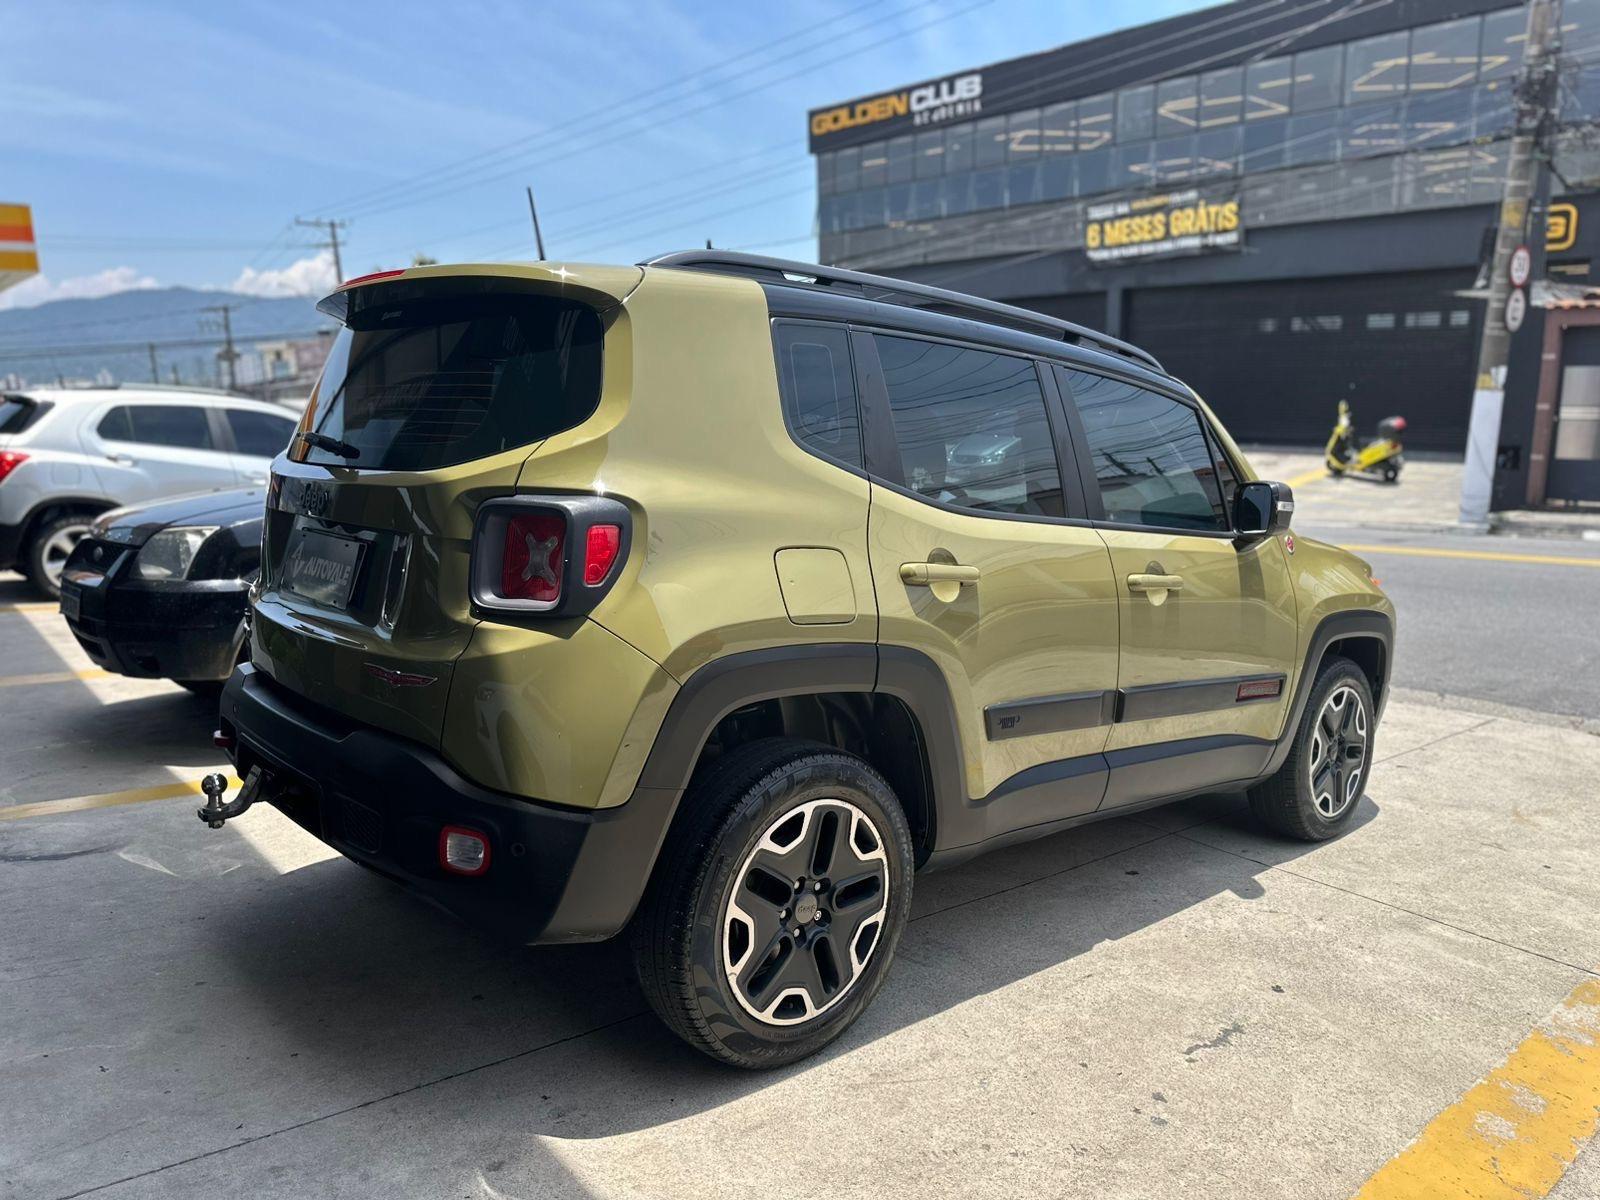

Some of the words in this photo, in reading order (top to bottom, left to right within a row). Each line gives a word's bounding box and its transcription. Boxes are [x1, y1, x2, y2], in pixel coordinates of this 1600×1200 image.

[812, 92, 909, 136] GOLDEN
[910, 74, 983, 112] CLUB
[1086, 223, 1100, 248] 6
[1104, 212, 1166, 246] MESES
[1169, 199, 1239, 236] GRÁTIS
[304, 556, 351, 585] AUTOVALE
